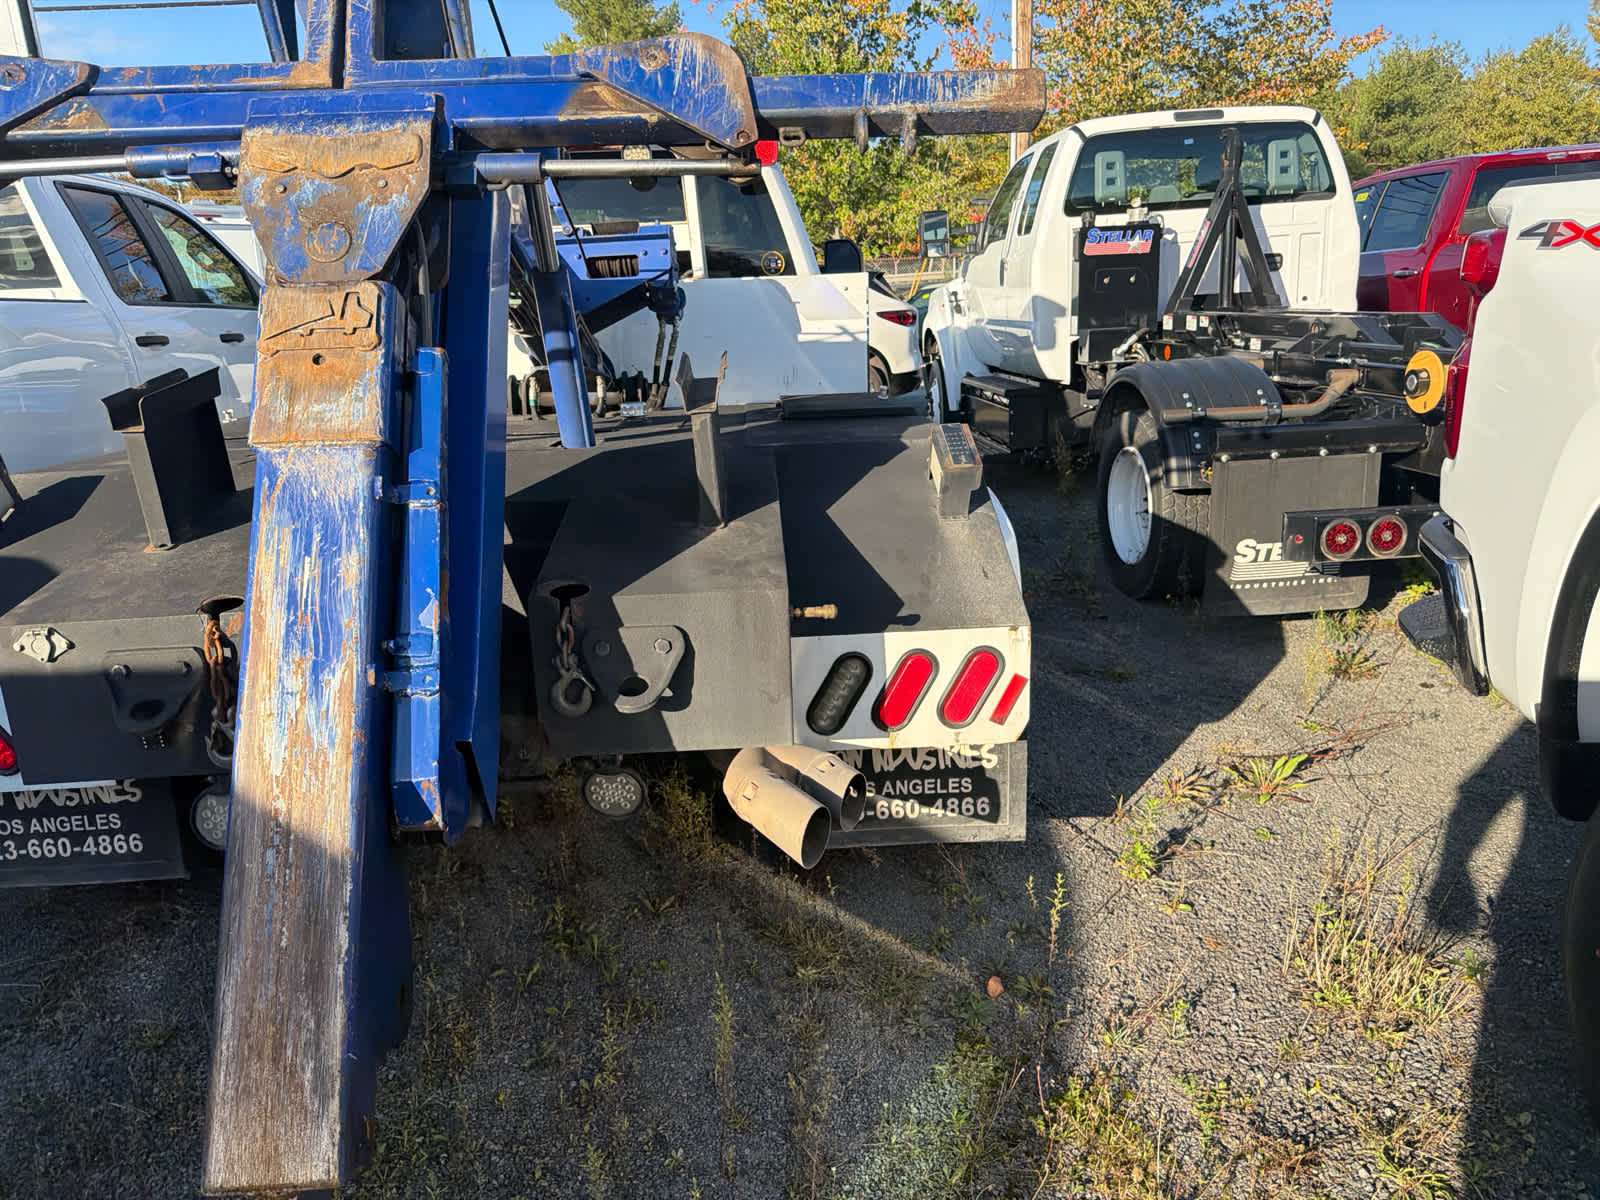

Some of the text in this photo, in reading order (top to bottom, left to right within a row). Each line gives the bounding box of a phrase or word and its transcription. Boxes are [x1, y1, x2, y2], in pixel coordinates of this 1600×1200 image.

[1086, 227, 1155, 244] STELLAR
[1230, 580, 1306, 589] INDUSTRIES
[881, 776, 973, 796] ANGELES
[30, 813, 121, 833] ANGELES
